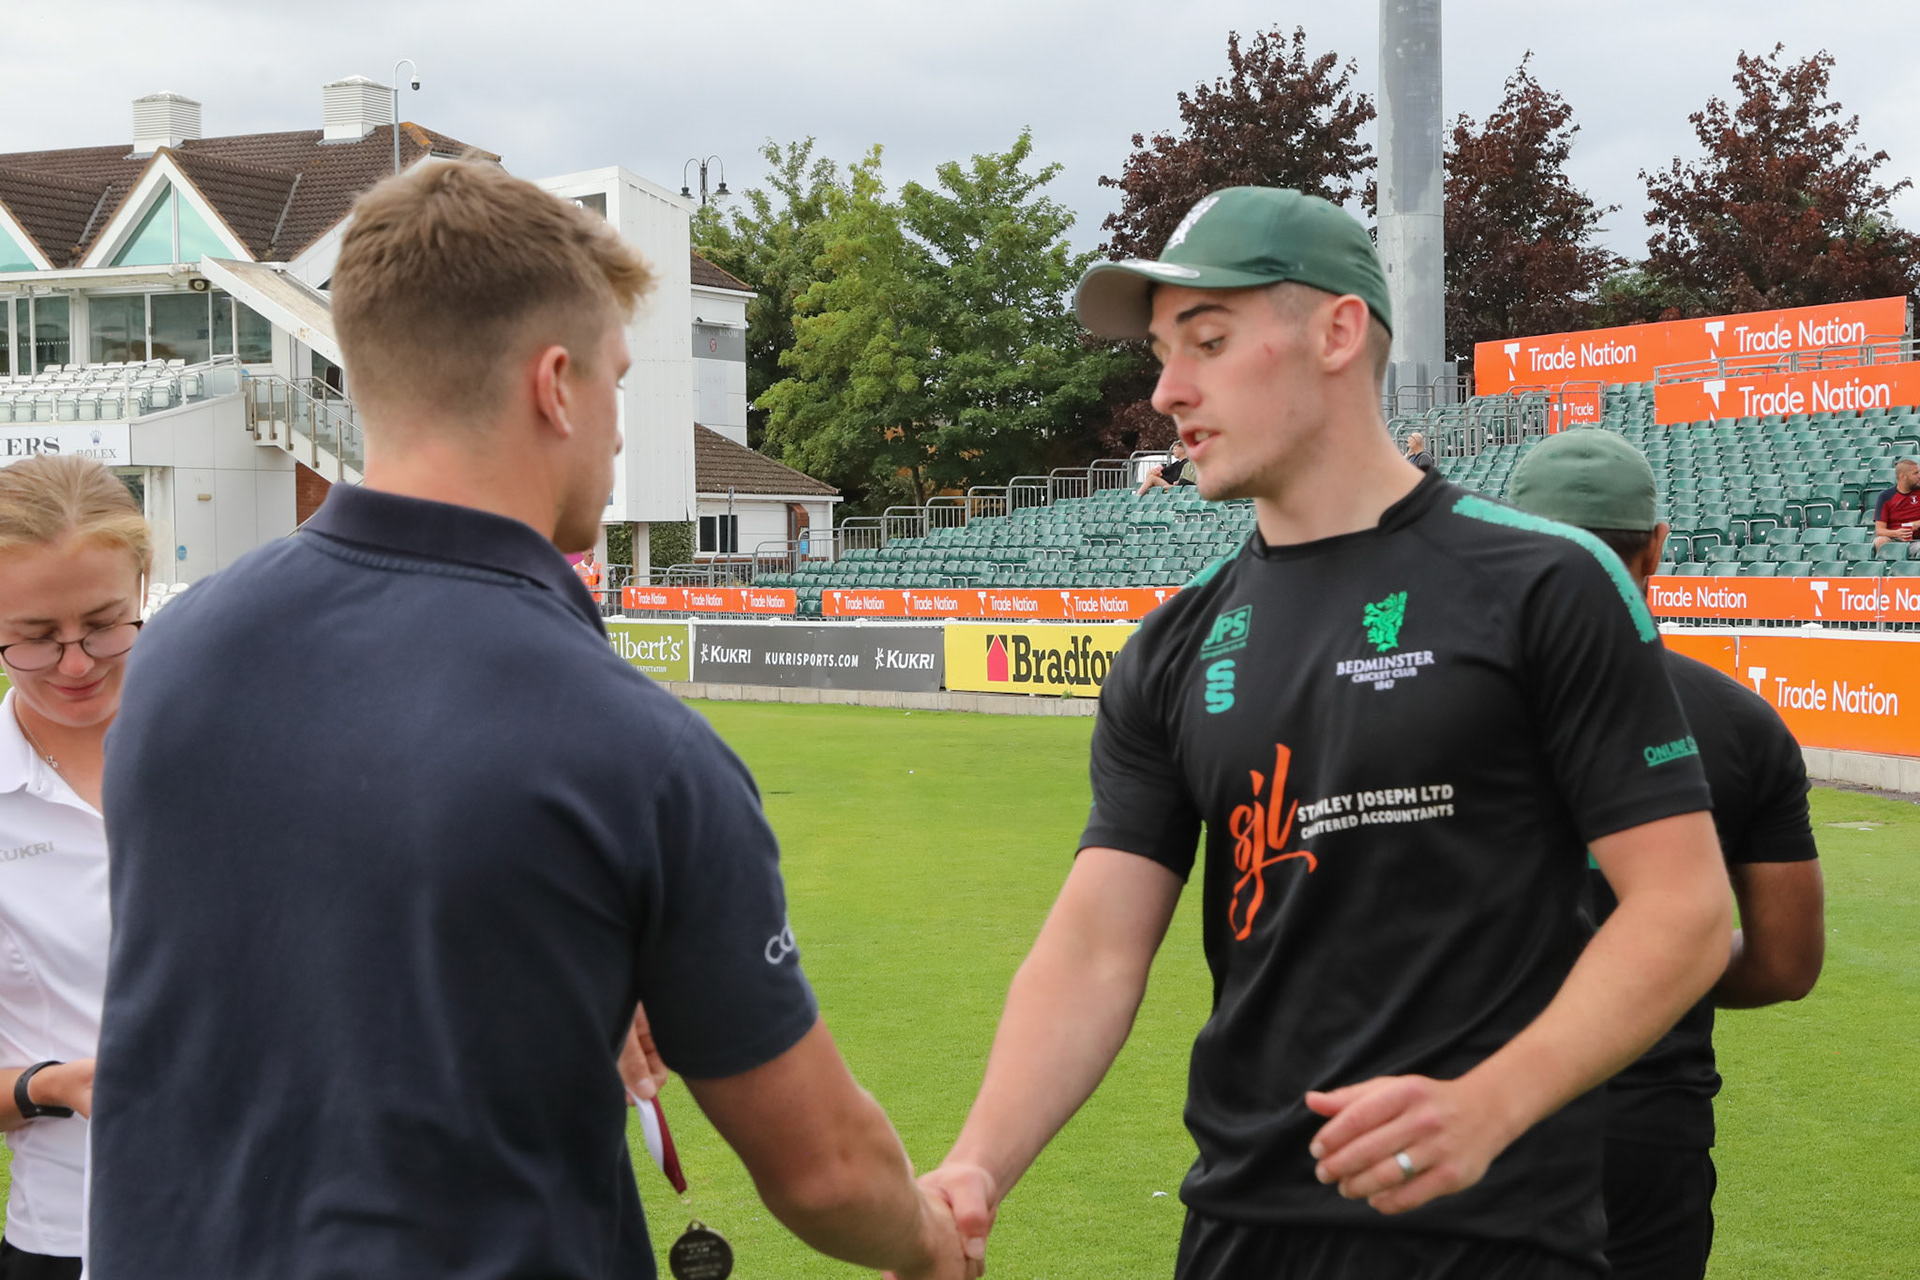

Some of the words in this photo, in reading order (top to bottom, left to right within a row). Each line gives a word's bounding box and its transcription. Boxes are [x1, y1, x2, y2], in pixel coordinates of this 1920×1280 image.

[1735, 320, 1792, 354] Trade
[1798, 316, 1866, 348] Nation
[1528, 344, 1576, 372] Trade
[1580, 339, 1637, 368] Nation
[1738, 382, 1806, 417] Trade
[1811, 377, 1890, 411] Nation
[1569, 402, 1595, 417] Trade
[0, 436, 61, 456] ERS
[637, 592, 651, 604] Trade
[650, 592, 667, 605] Nation
[690, 593, 705, 606] Trade
[705, 594, 723, 607] Nation
[749, 594, 766, 608] Trade
[766, 595, 786, 608] Nation
[844, 595, 862, 610] Trade
[862, 595, 885, 610] Nation
[912, 595, 933, 611] Trade
[933, 595, 958, 611] Nation
[989, 595, 1012, 612] Trade
[1012, 596, 1039, 612] Nation
[1075, 595, 1100, 612] Trade
[1100, 595, 1129, 613] Nation
[1650, 585, 1692, 608] Trade
[1696, 586, 1747, 609] Nation
[1837, 587, 1890, 612] Trade
[607, 631, 681, 662] ilbert's
[710, 645, 751, 664] KUKRI
[765, 651, 859, 669] KUKRISPORTS.COM
[887, 649, 935, 670] KUKRI
[1336, 650, 1435, 676] BEDMINSTER
[1775, 676, 1827, 711] Trade
[1832, 680, 1899, 716] Nation
[1356, 786, 1418, 812] JOSEPH
[1420, 783, 1454, 802] LTD
[1360, 803, 1455, 825] ACCOUNTANTS
[0, 840, 55, 863] UKRI
